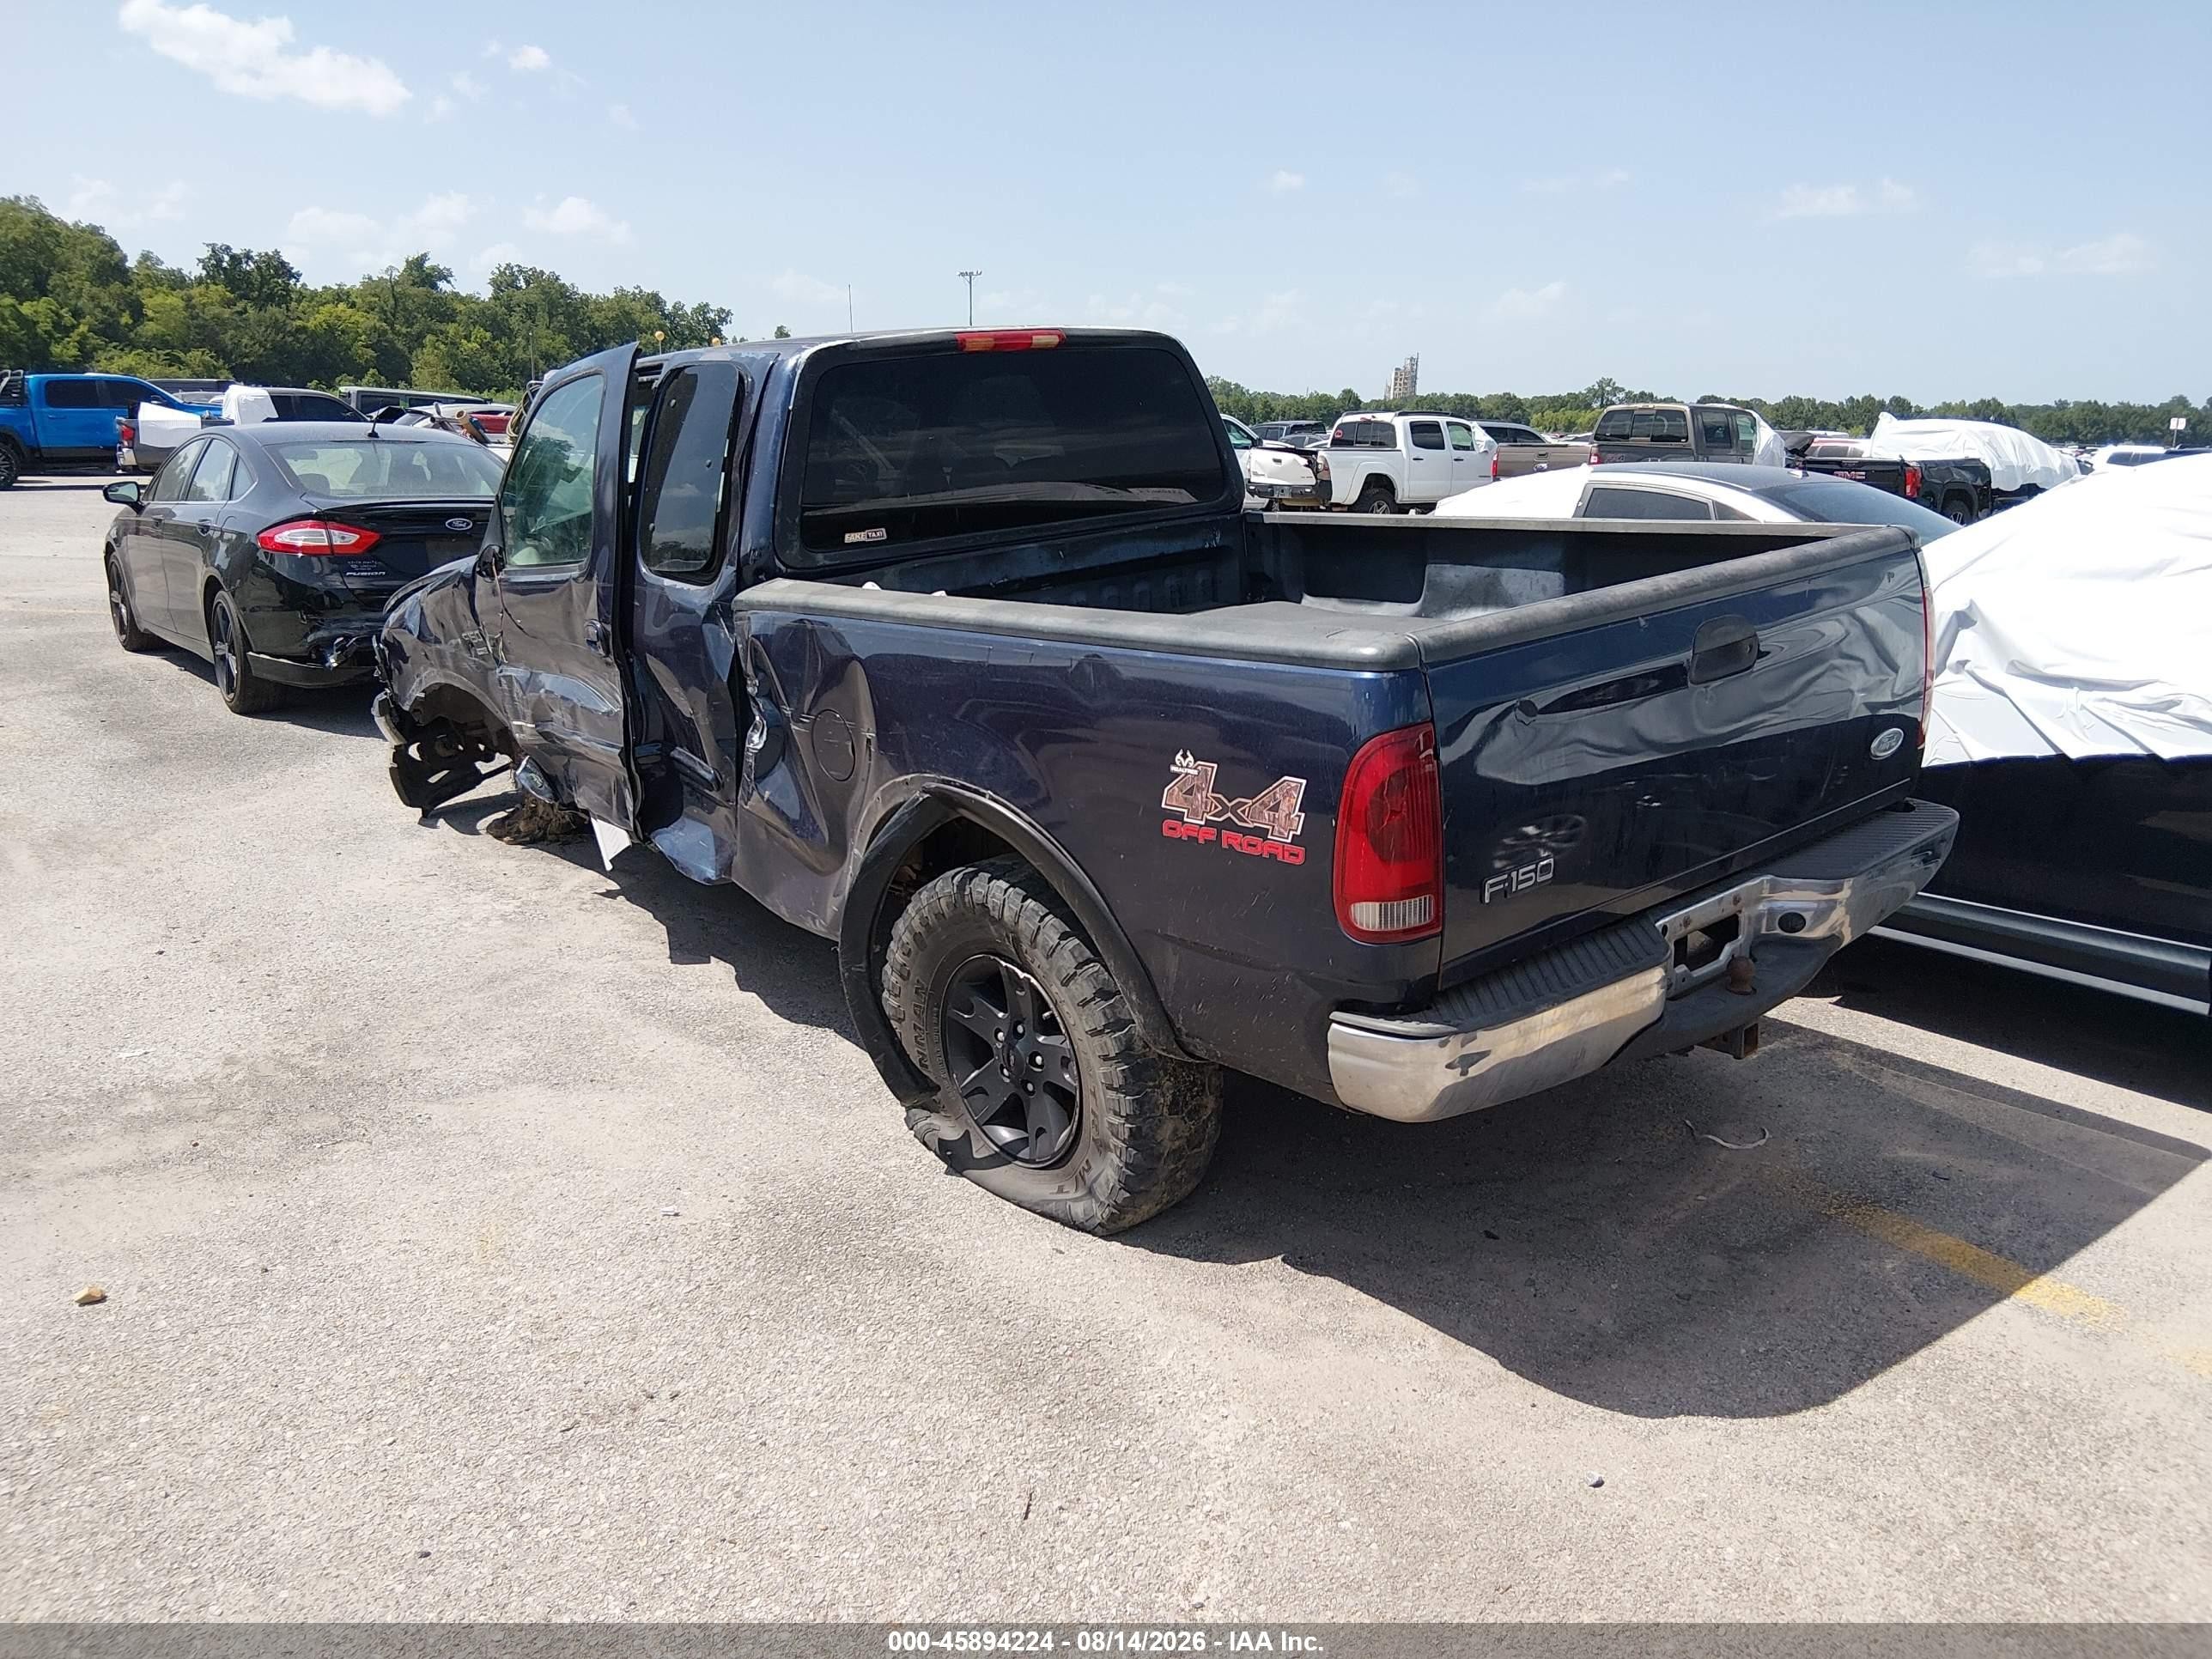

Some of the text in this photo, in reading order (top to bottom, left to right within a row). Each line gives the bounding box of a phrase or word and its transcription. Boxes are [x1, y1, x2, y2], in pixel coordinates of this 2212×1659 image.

[867, 531, 884, 539] TAXI
[1162, 819, 1306, 866] OFF ROAD
